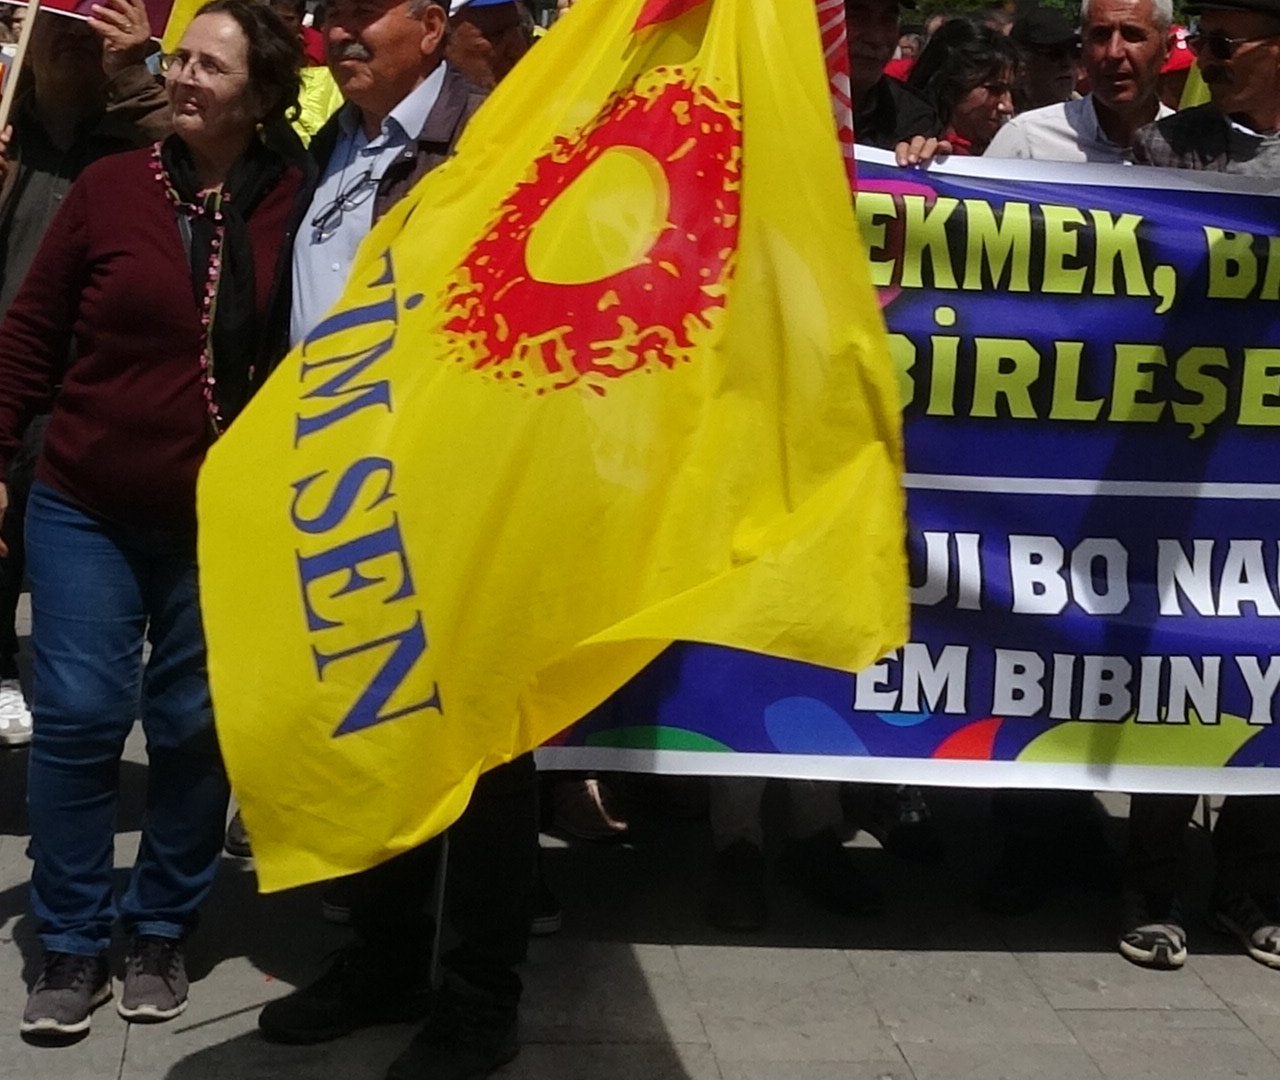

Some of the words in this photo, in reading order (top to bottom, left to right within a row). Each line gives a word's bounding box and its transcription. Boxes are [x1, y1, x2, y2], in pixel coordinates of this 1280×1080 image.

[854, 191, 1177, 314] EKMEK,
[289, 457, 444, 740] SEN
[1009, 533, 1129, 616] BO
[854, 642, 969, 715] EM
[991, 648, 1221, 724] BIBIN
